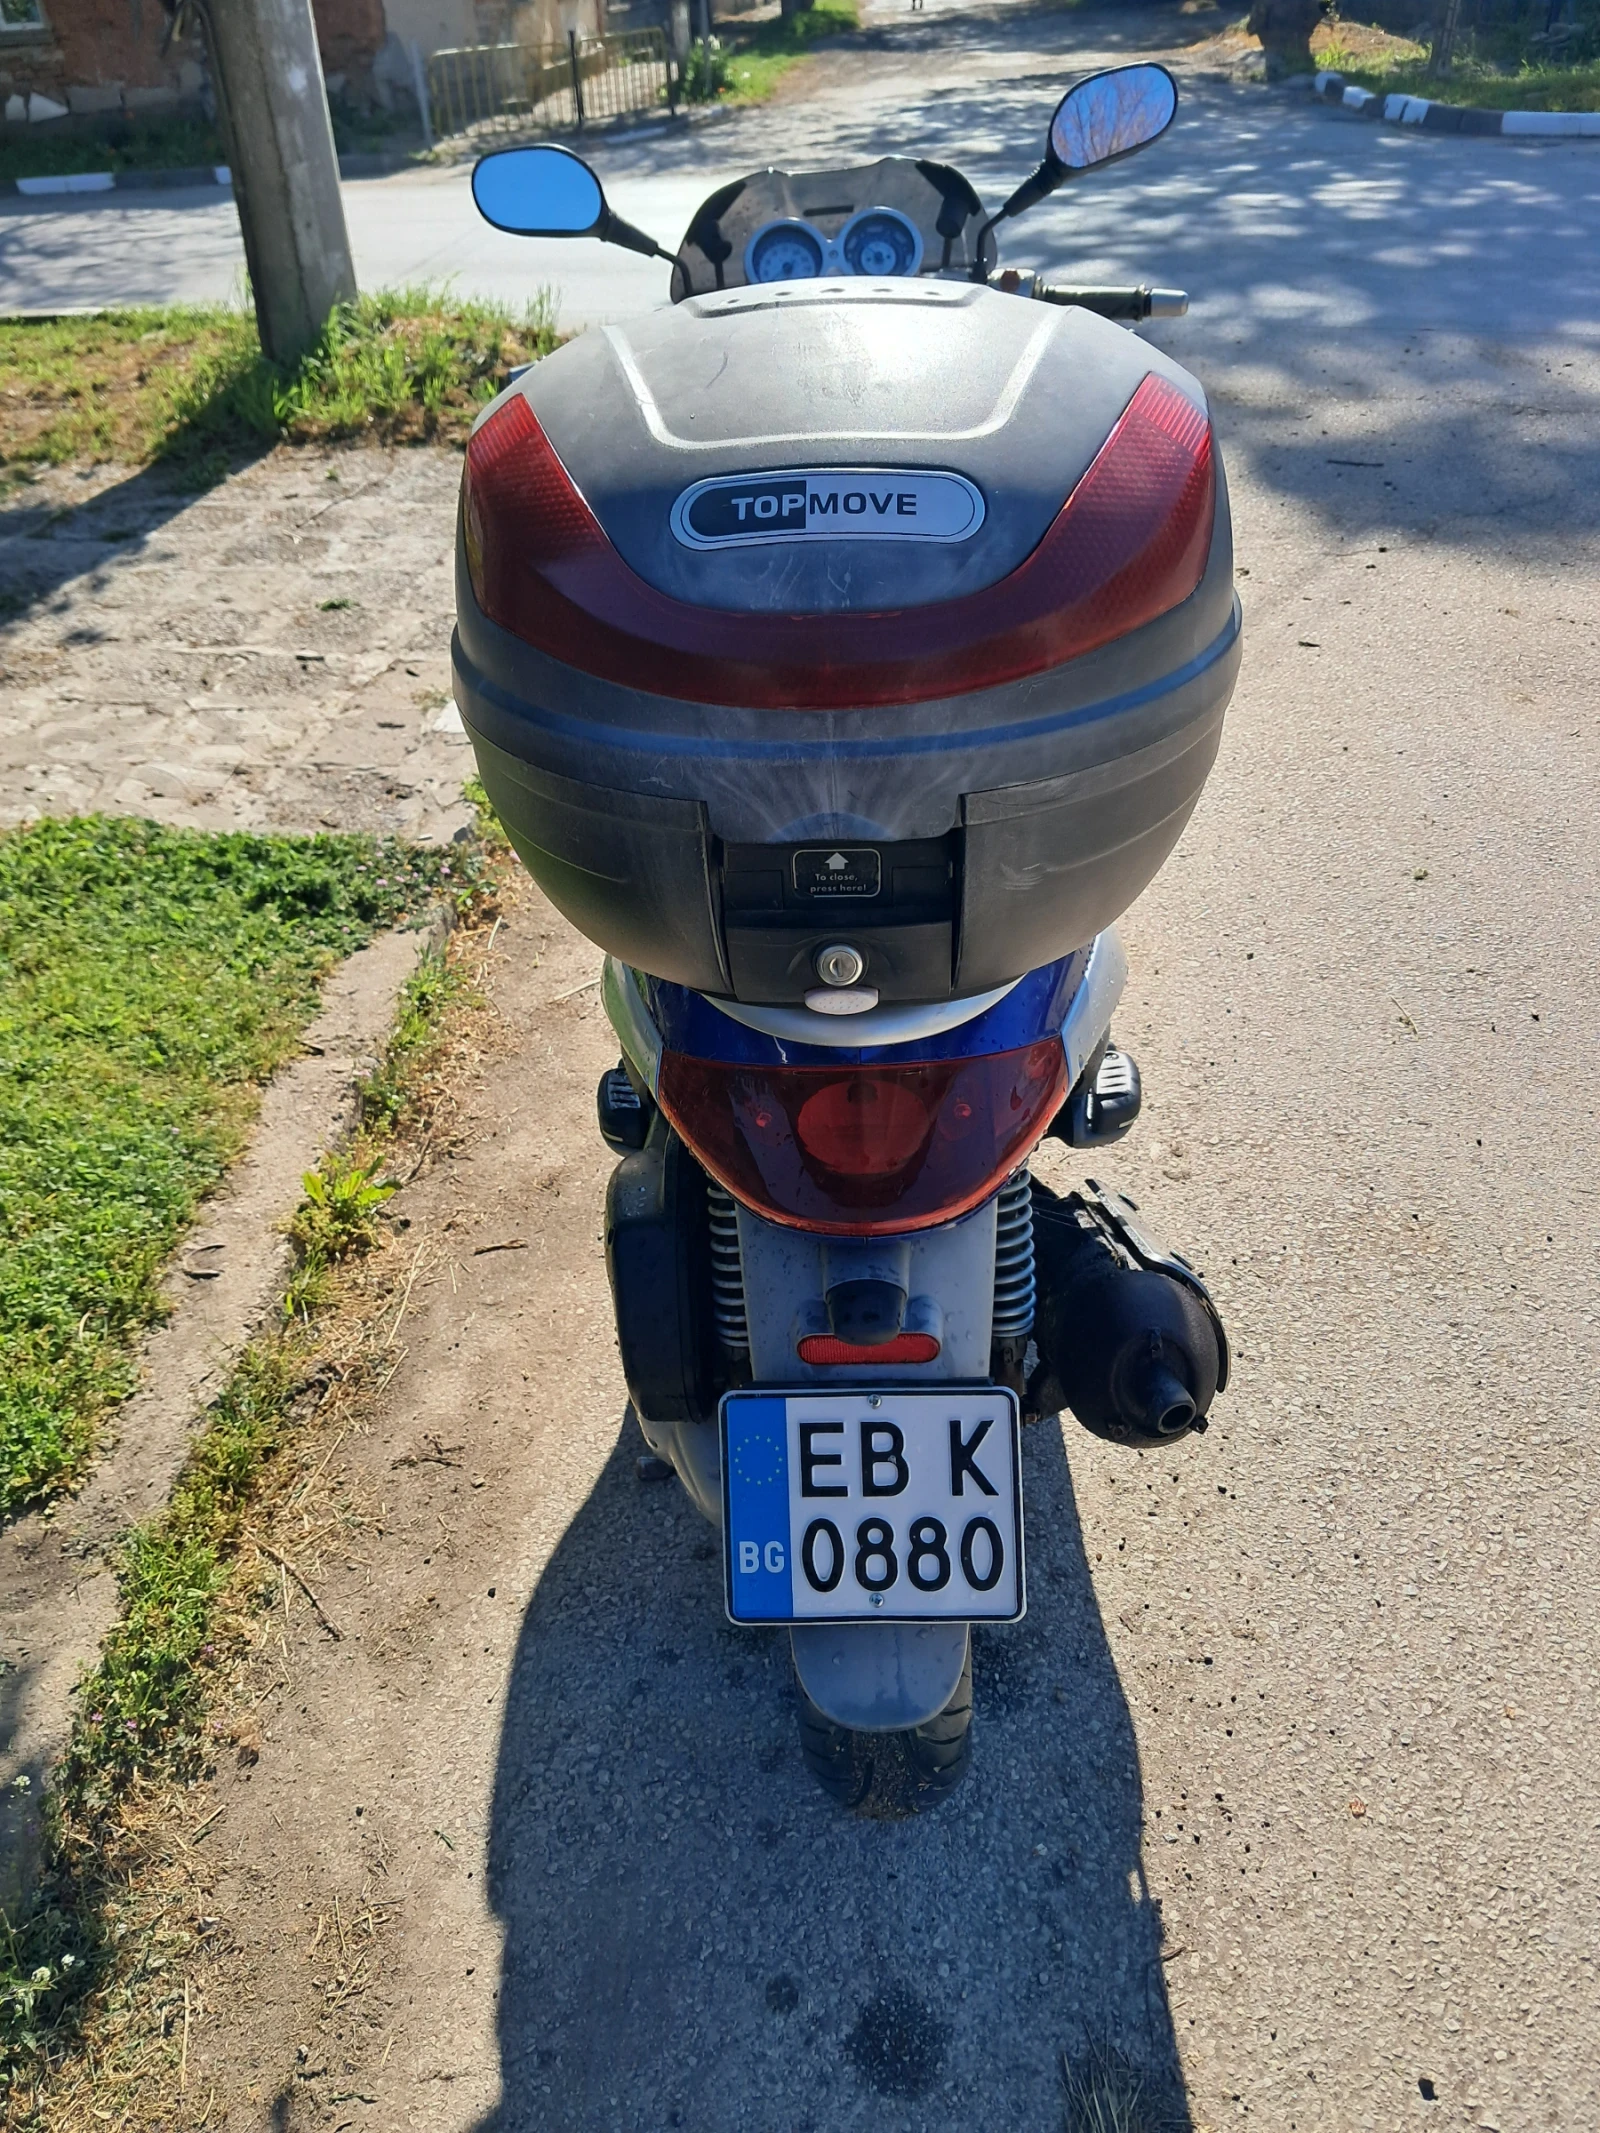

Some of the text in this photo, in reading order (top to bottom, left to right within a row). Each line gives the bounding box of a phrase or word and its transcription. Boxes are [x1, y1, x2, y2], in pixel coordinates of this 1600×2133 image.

[731, 493, 917, 520] TOPMOVE
[810, 883, 866, 893] press here!
[815, 873, 827, 881] To
[738, 1541, 785, 1573] BG
[802, 1516, 1004, 1592] 0880
